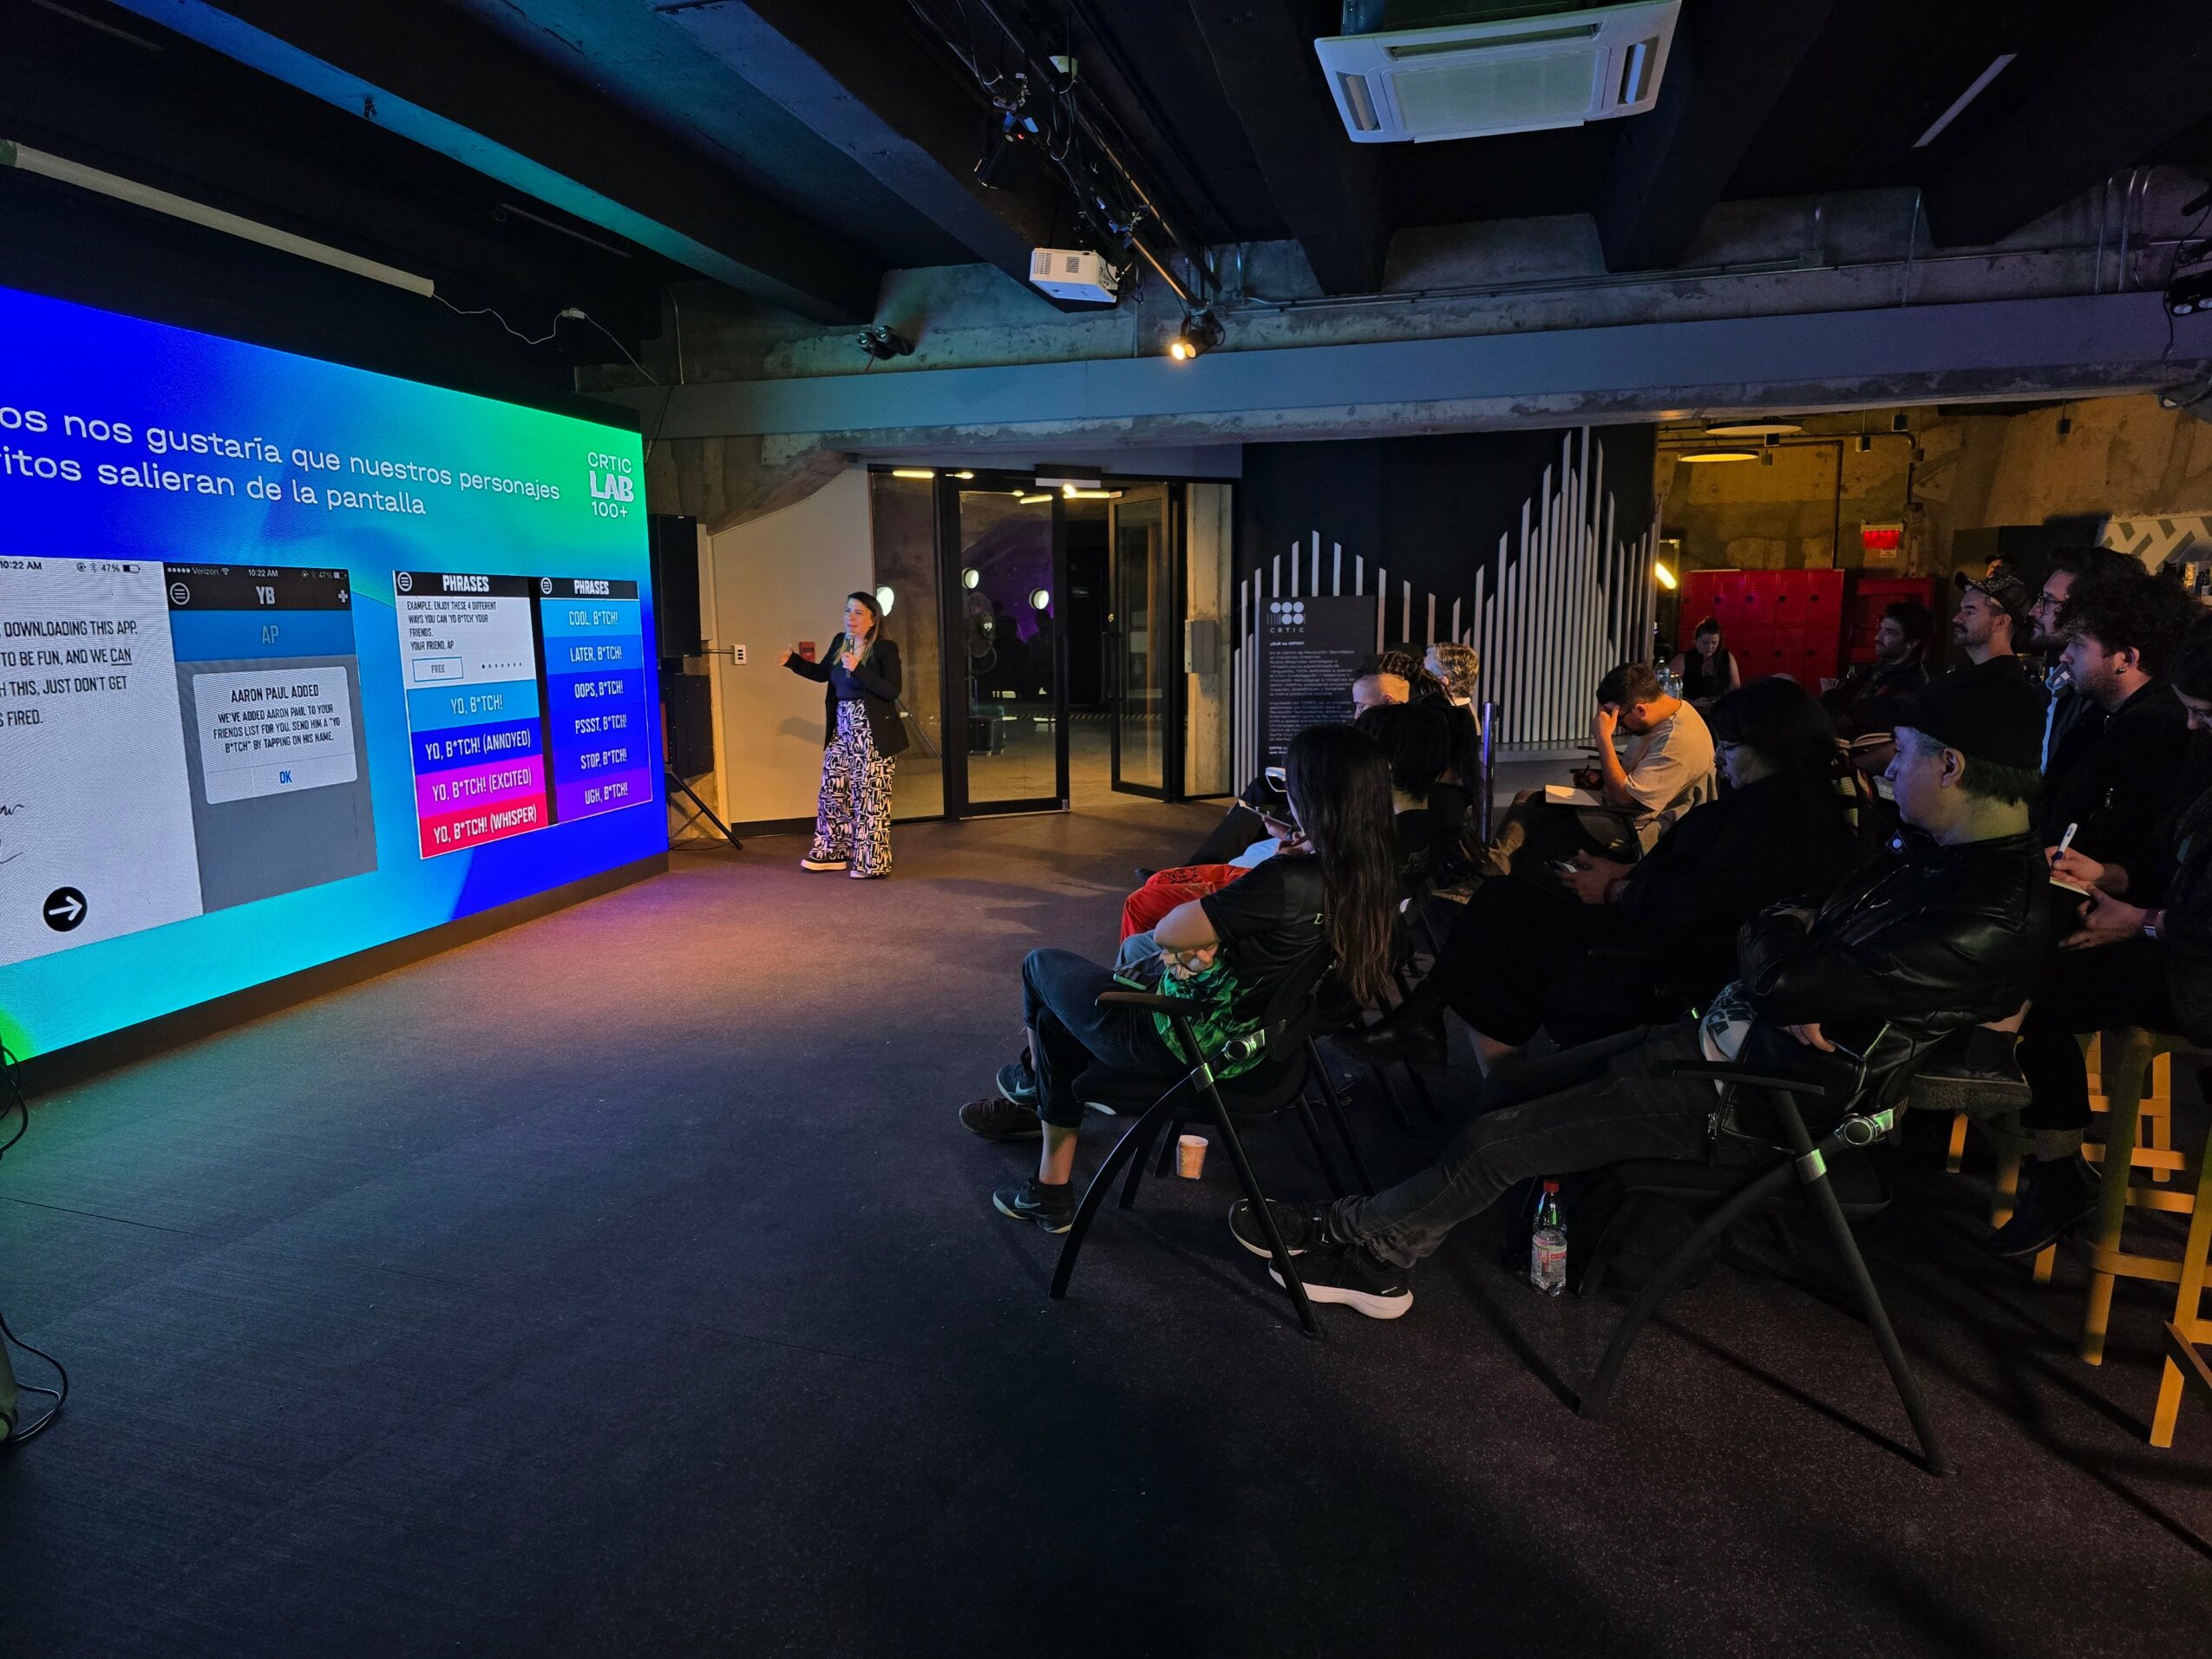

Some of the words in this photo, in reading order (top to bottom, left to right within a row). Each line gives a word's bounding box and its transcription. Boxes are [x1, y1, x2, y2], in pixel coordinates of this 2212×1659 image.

[64, 415, 133, 444] nos
[147, 428, 283, 464] gustaría
[291, 447, 341, 472] que
[350, 454, 452, 486] nuestros
[460, 472, 560, 500] personajes
[587, 452, 632, 474] CRTIC
[0, 445, 82, 481] itos
[97, 462, 236, 496] salieran
[246, 476, 282, 501] de
[293, 479, 318, 505] la
[327, 488, 427, 515] pantalla
[589, 470, 634, 502] LAB
[592, 500, 628, 518] 100+
[27, 561, 43, 571] AM
[192, 567, 219, 576] Verizon
[442, 575, 490, 592] PHRASES
[573, 579, 610, 595] PHRASES
[256, 586, 276, 604] YB
[434, 601, 450, 611] ENJOY
[451, 601, 467, 611] THESE
[468, 601, 472, 610] 4
[472, 601, 496, 611] DIFFERENT
[408, 614, 423, 624] WAYS
[424, 614, 435, 624] YOU
[436, 614, 448, 624] CAN
[475, 614, 488, 624] YOUR
[569, 611, 592, 626] COOL,
[4, 621, 87, 637] DOWNLOADING
[89, 621, 114, 636] THIS
[117, 620, 138, 635] APP.
[262, 625, 278, 644] AP
[409, 641, 425, 651] YOUR
[448, 640, 455, 650] AP
[1, 652, 16, 667] TO
[20, 651, 35, 666] BE
[37, 650, 63, 666] FUN,
[66, 650, 88, 664] AND
[90, 649, 108, 663] WE
[111, 648, 132, 663] CAN
[570, 647, 596, 663] LATER,
[431, 664, 446, 674] FREE
[43, 679, 70, 695] JUST
[75, 677, 106, 692] DON'T
[108, 676, 128, 689] GET
[232, 687, 263, 703] AARON
[266, 686, 289, 700] PAUL
[291, 684, 319, 698] ADDED
[574, 683, 598, 698] OOPS,
[218, 712, 241, 723] WE'VE
[243, 710, 265, 722] ADDED
[267, 708, 290, 719] AARON
[291, 707, 306, 716] PAUL
[307, 706, 316, 715] TO
[317, 704, 334, 714] YOUR
[450, 697, 468, 715] YO,
[7, 709, 43, 726] FIRED.
[575, 717, 601, 735] PSSST,
[213, 727, 243, 739] FRIENDS
[244, 725, 260, 736] LIST
[261, 723, 274, 735] FOR
[275, 722, 291, 732] YOU.
[292, 720, 310, 731] SEND
[311, 719, 322, 728] HIM
[324, 718, 328, 727] A
[253, 739, 262, 750] BY
[264, 736, 291, 748] TAPPING
[292, 735, 302, 746] ON
[303, 733, 313, 743] HIS
[315, 731, 334, 741] NAME.
[425, 743, 443, 761] YO,
[482, 728, 531, 754] (ANNOYED)
[580, 754, 601, 769] STOP,
[279, 770, 292, 784] OK
[432, 784, 449, 802] YO,
[488, 767, 532, 793] (EXCITED)
[585, 787, 603, 805] UGH,
[433, 826, 451, 844] YO,
[490, 804, 537, 833] (WHISPER)
